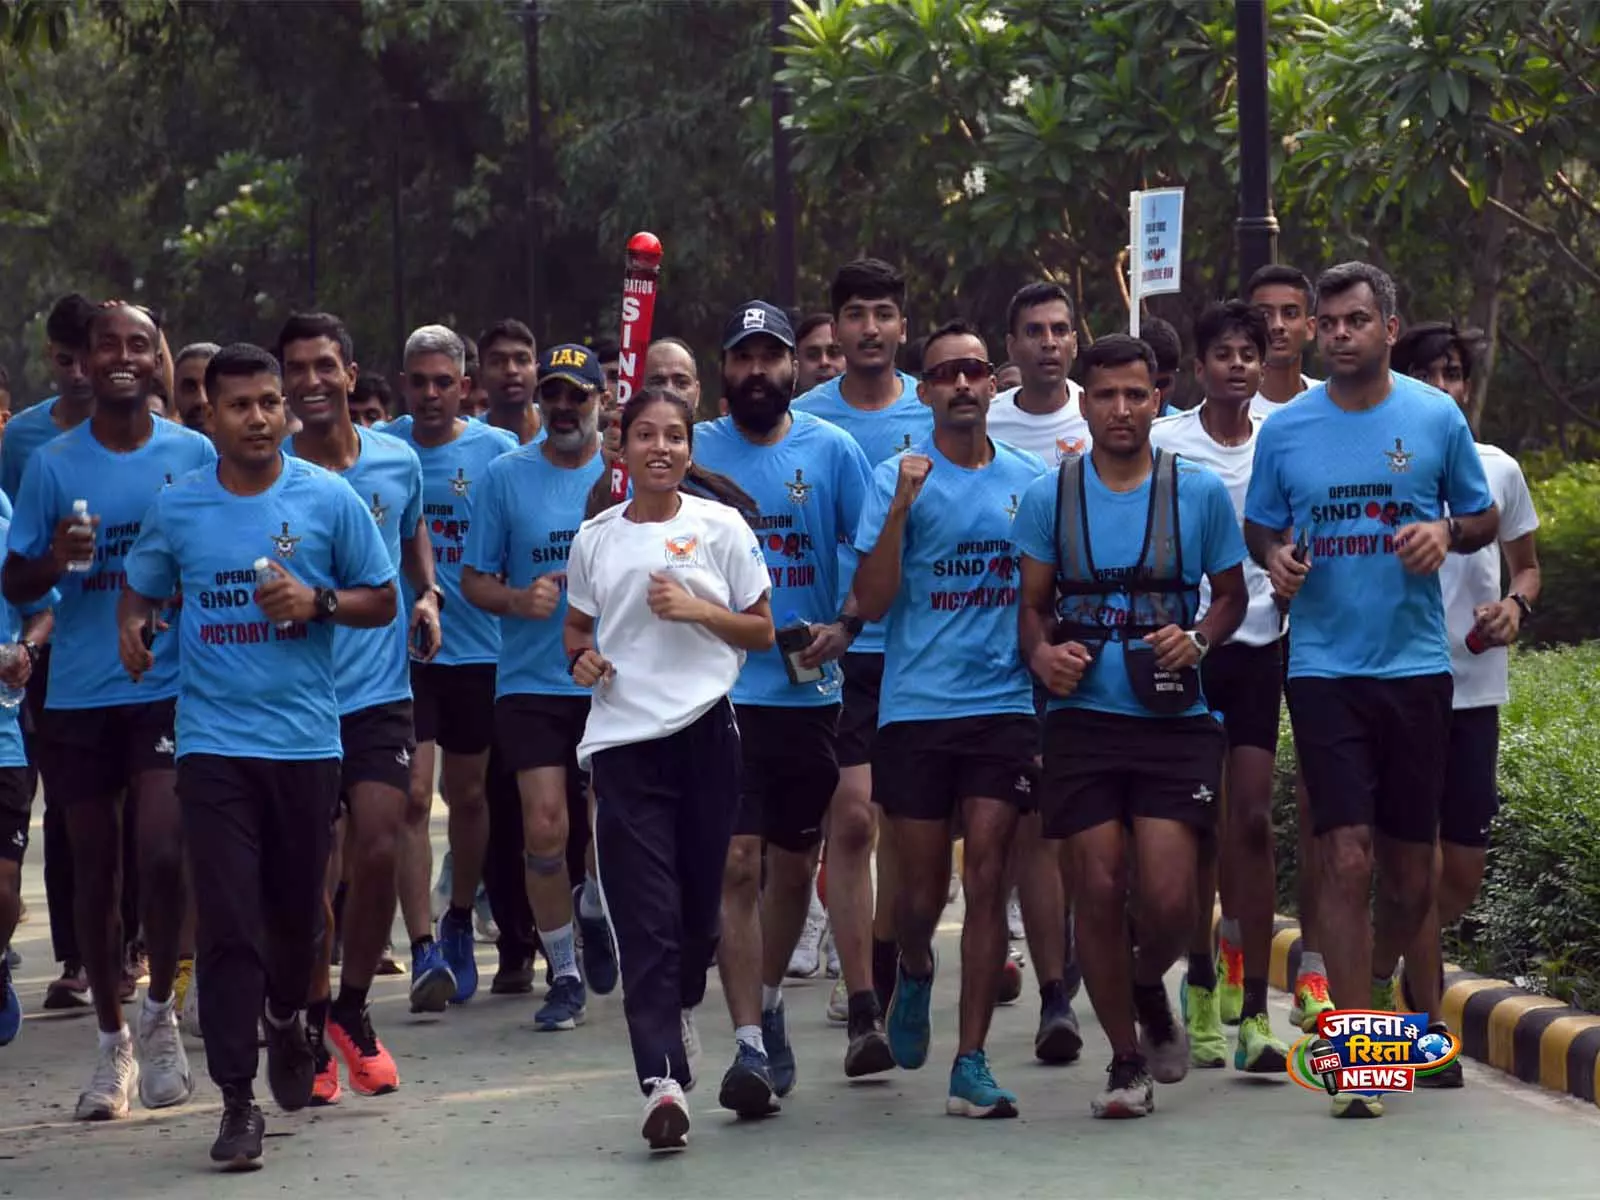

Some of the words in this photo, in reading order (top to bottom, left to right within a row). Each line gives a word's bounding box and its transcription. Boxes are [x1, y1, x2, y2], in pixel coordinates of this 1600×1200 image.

[624, 278, 653, 294] RATION
[551, 349, 587, 367] IAF
[1328, 483, 1393, 498] OPERATION
[1311, 533, 1378, 557] VICTORY
[215, 569, 257, 585] OPERAT
[787, 565, 816, 588] RUN
[199, 588, 250, 610] SIND
[200, 620, 269, 645] VICTORY
